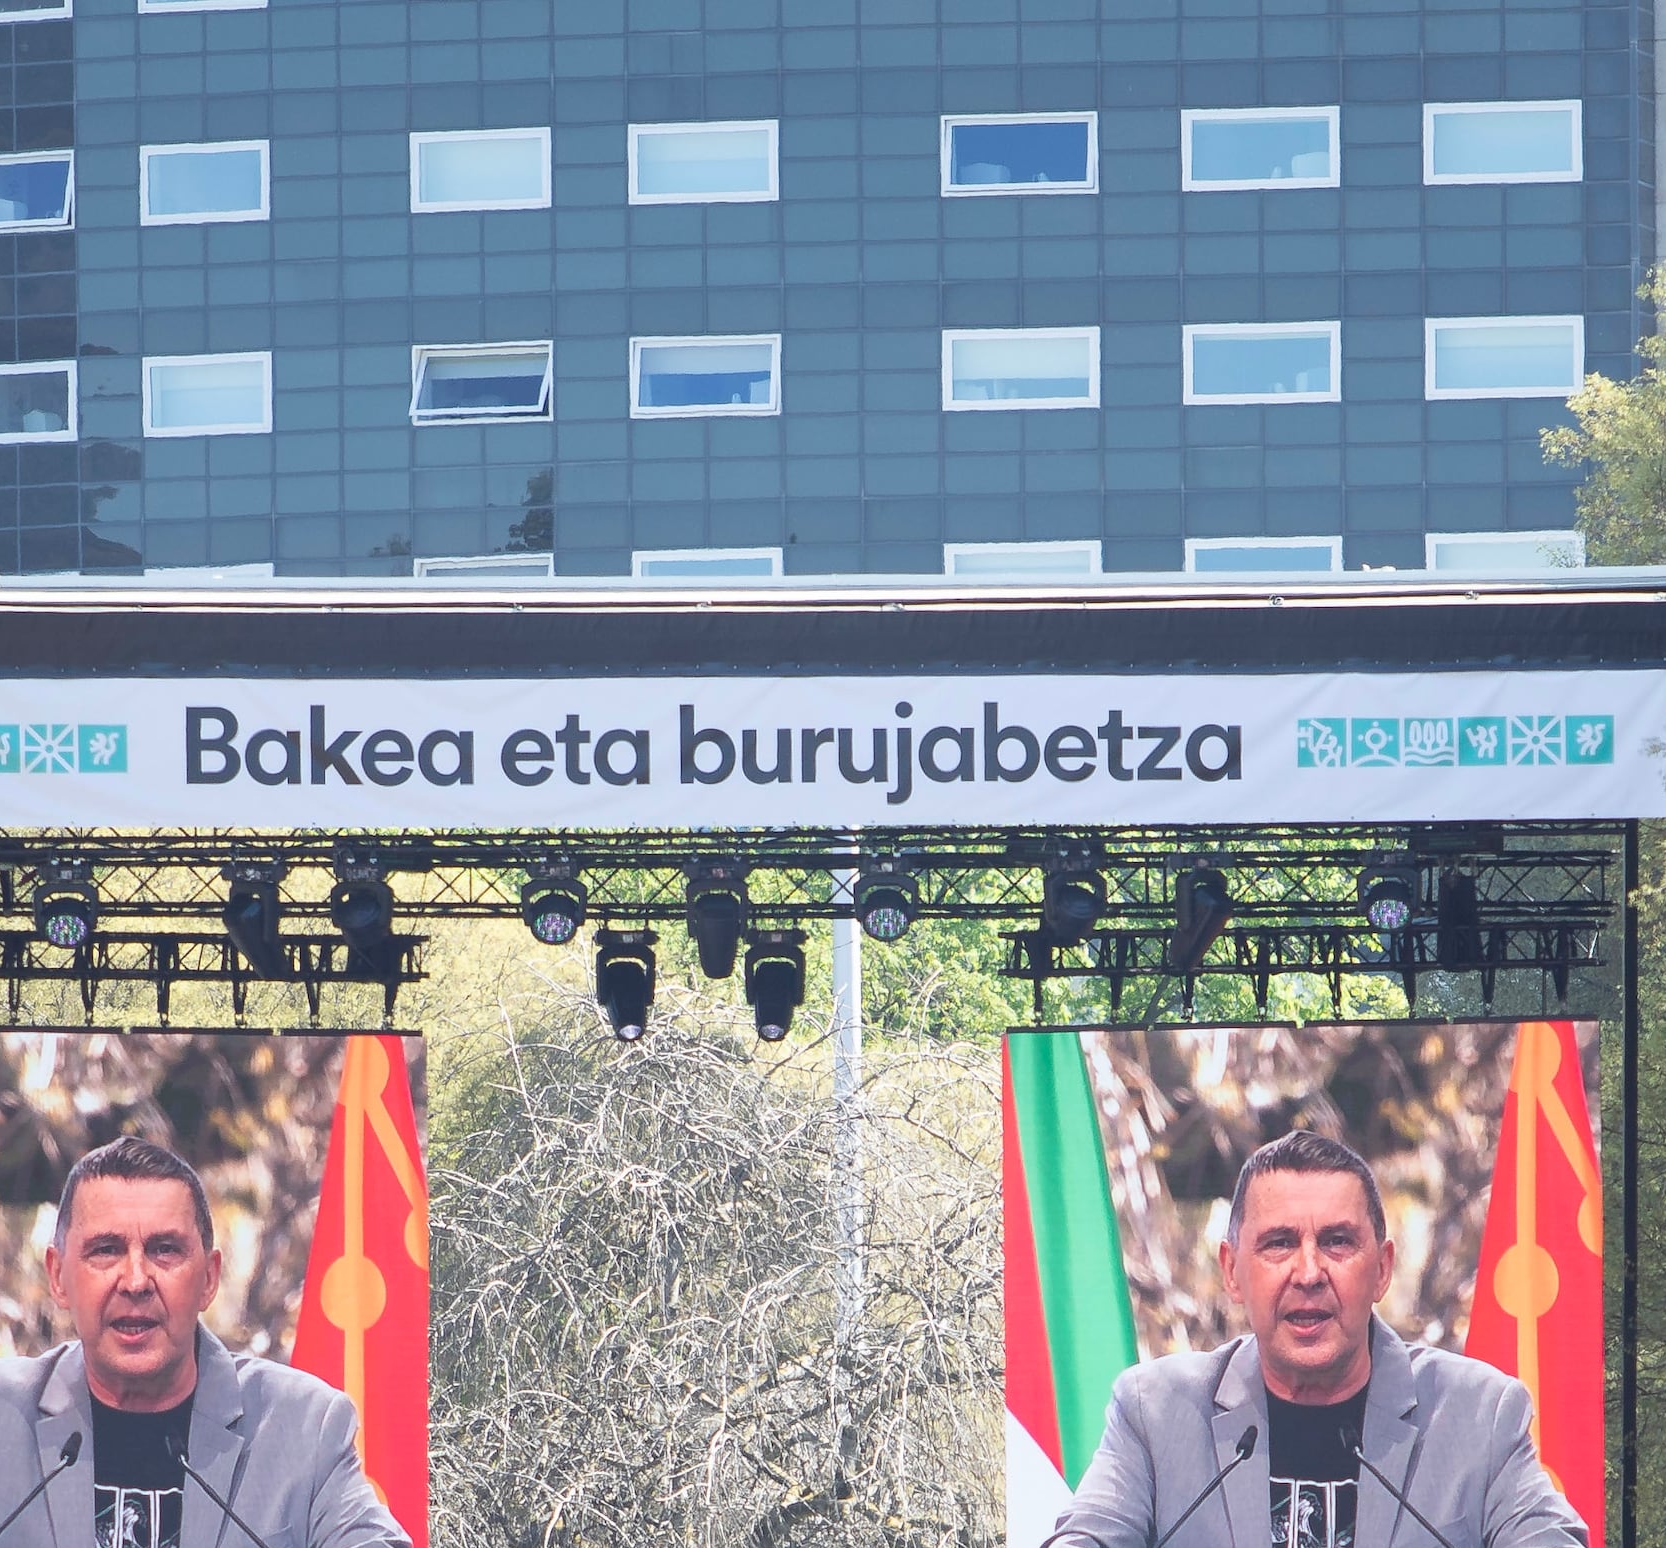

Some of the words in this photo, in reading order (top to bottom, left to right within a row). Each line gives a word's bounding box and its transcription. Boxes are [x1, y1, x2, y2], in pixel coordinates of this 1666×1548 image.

[186, 705, 474, 786] Bakea
[501, 714, 650, 787] eta
[679, 701, 1242, 805] burujabetza
